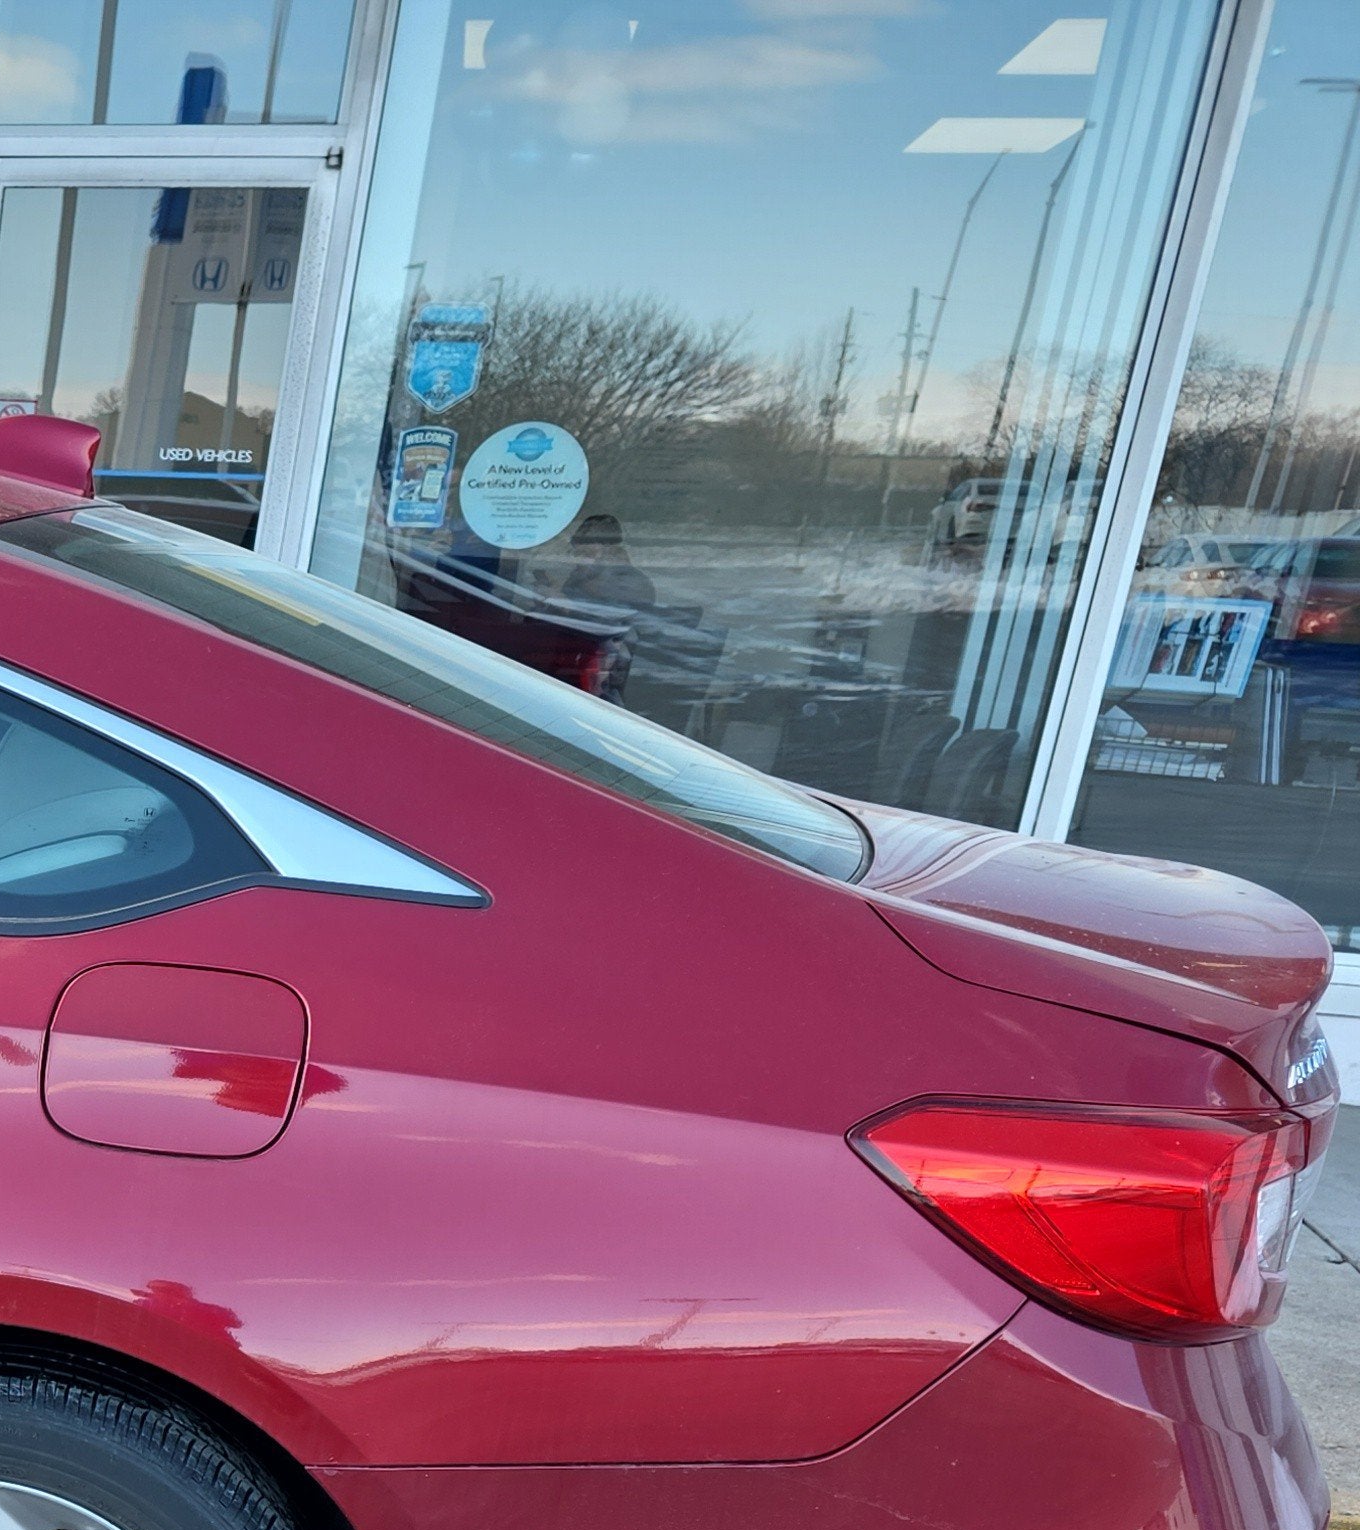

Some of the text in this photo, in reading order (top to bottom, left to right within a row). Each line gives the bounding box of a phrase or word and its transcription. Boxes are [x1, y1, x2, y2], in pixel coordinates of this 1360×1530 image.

[405, 431, 452, 446] WELCOME
[160, 446, 253, 463] USED VEHICLES
[487, 464, 566, 475] A New Level of
[467, 478, 582, 490] Certified Pre-Owned
